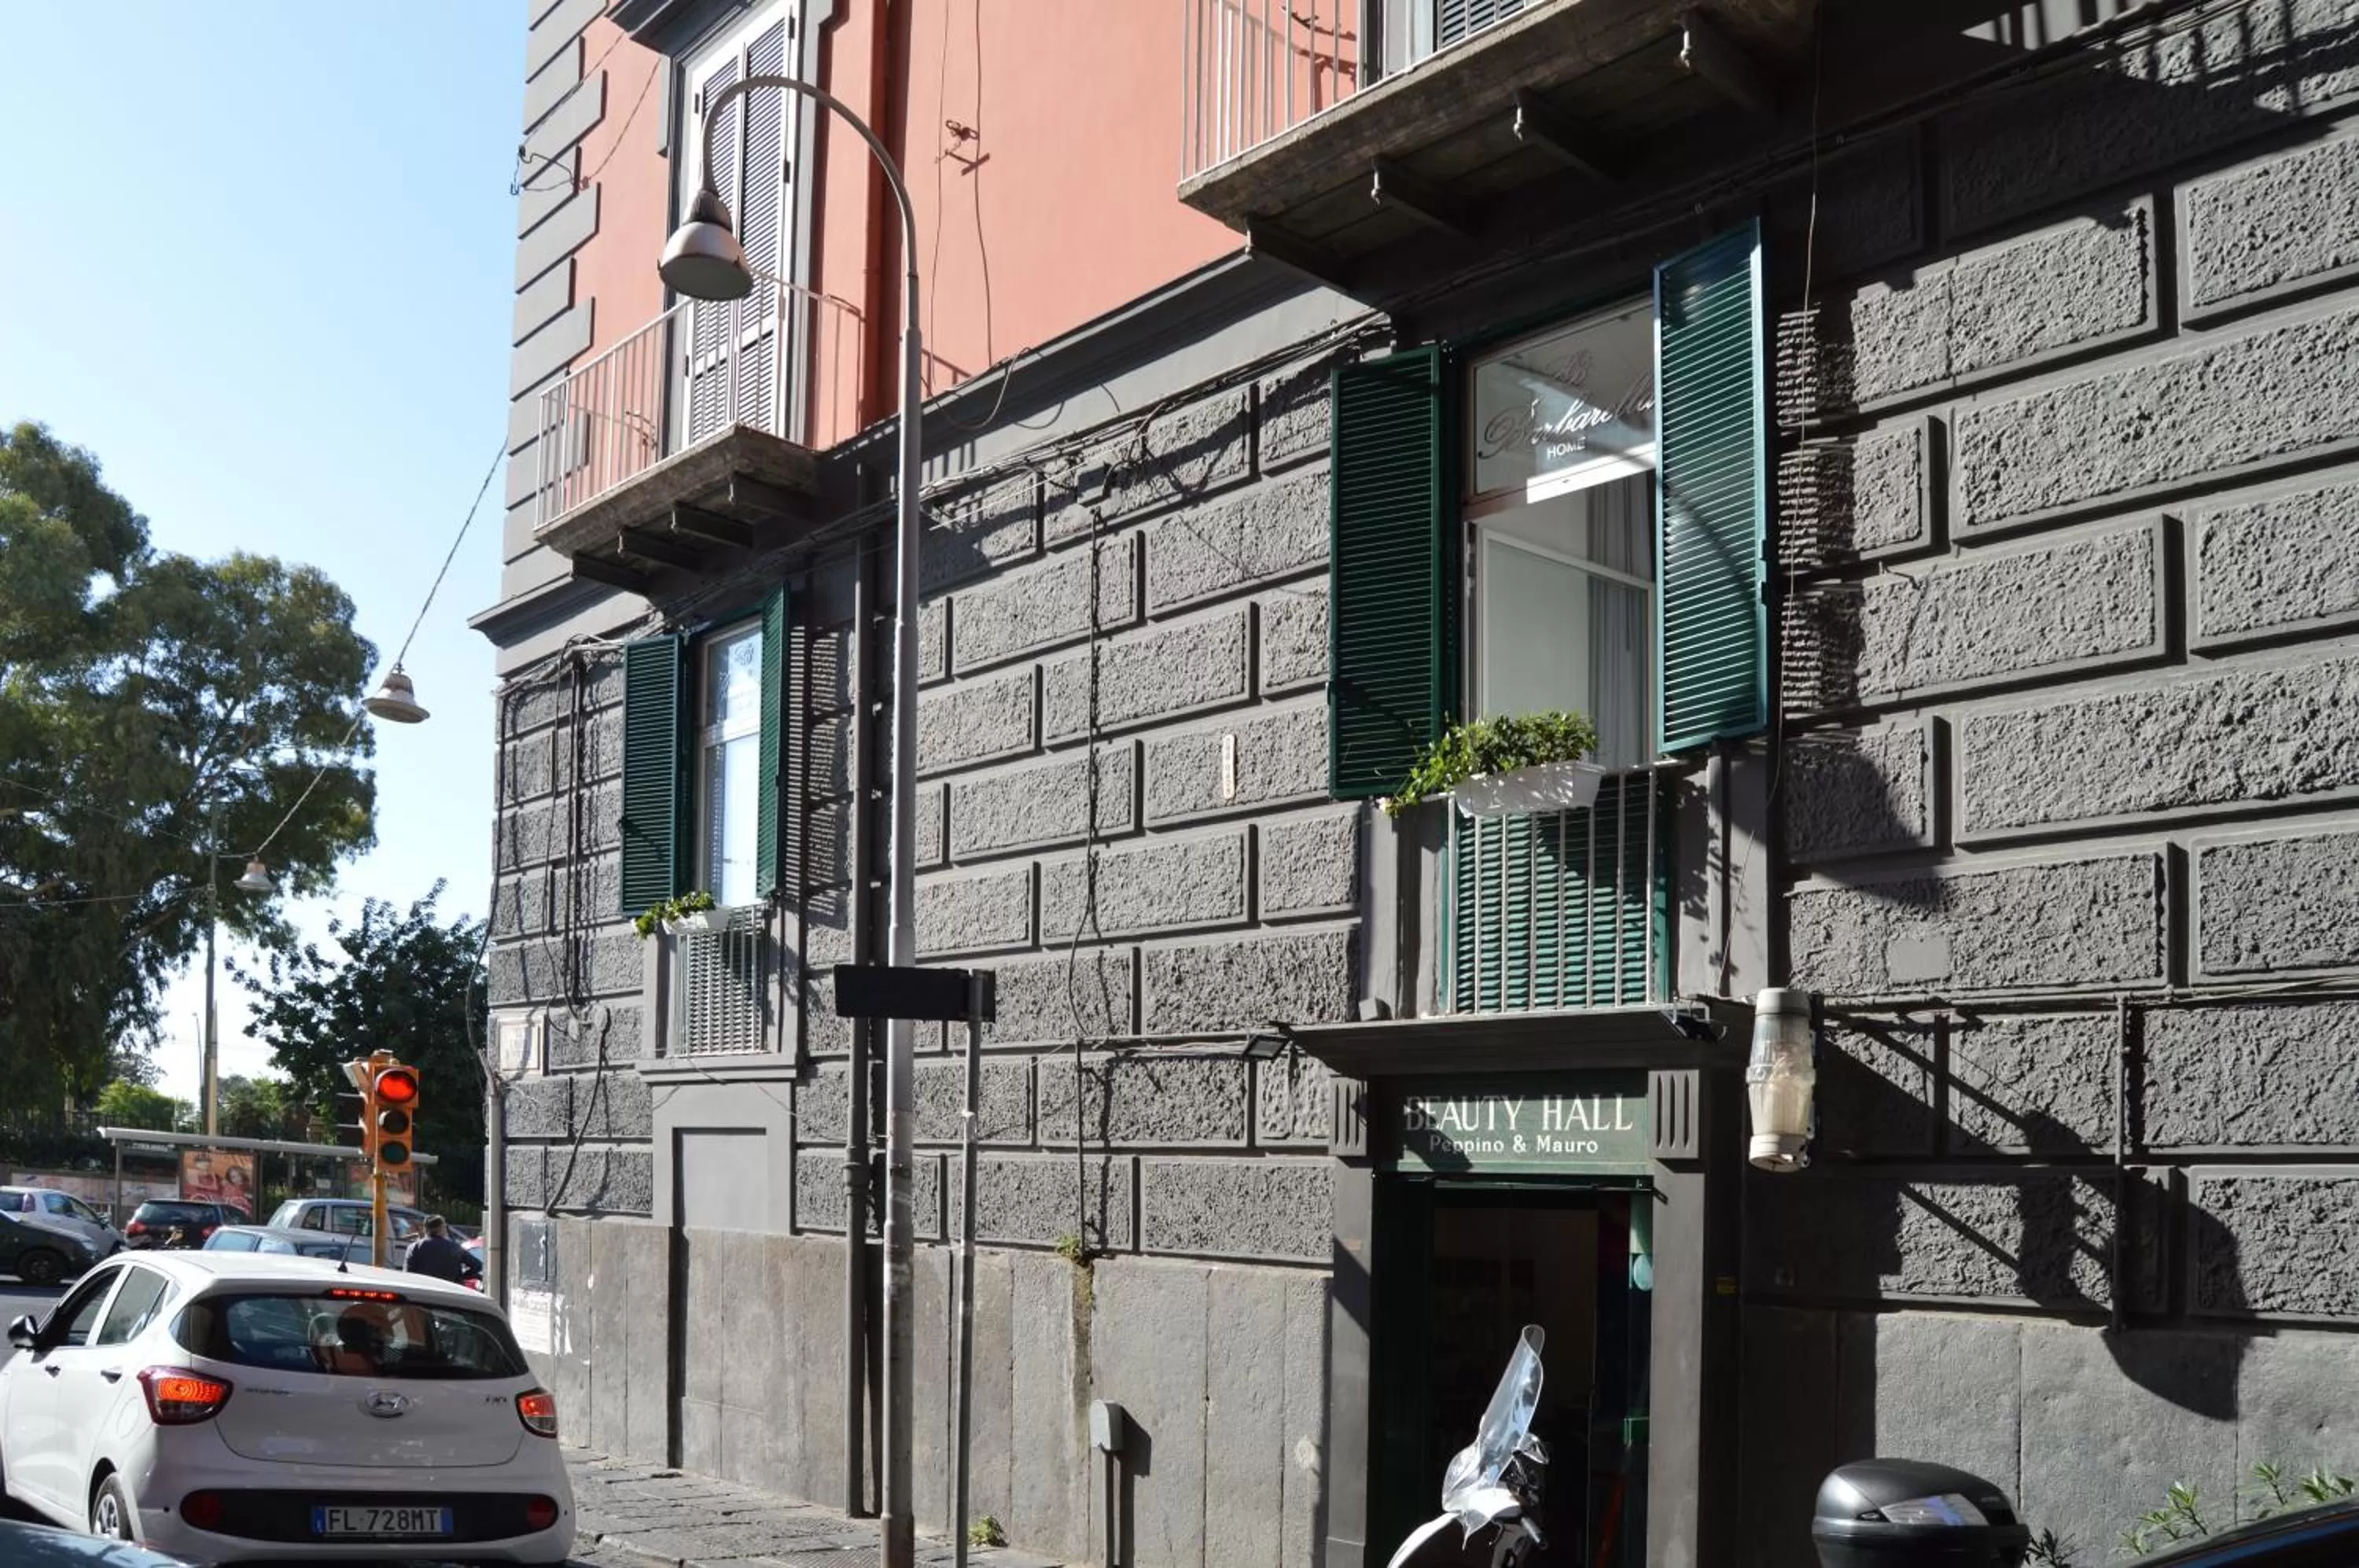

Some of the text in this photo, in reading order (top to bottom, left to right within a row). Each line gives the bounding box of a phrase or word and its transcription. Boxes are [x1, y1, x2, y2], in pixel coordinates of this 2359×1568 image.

[1547, 436, 1586, 460] HOME
[1404, 1092, 1633, 1131] BEAUTY HALL
[1430, 1134, 1599, 1154] Peppino & Mauro
